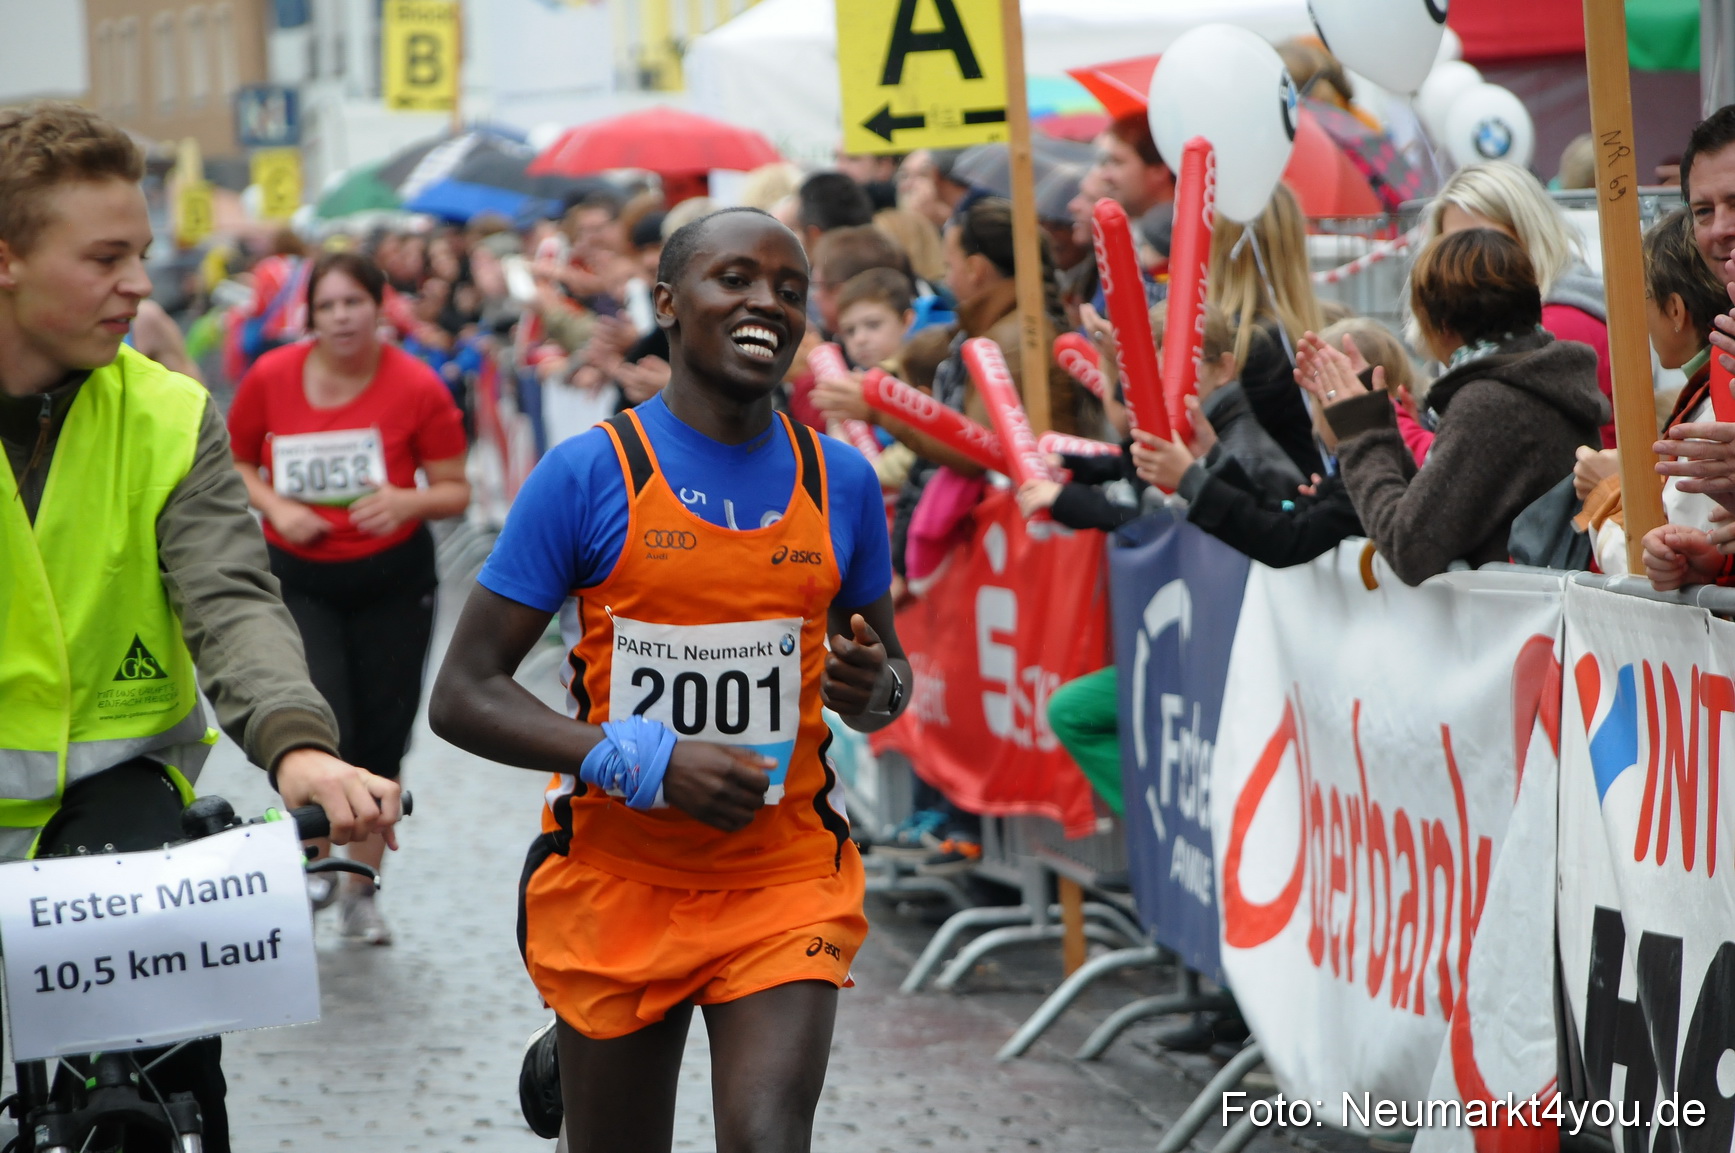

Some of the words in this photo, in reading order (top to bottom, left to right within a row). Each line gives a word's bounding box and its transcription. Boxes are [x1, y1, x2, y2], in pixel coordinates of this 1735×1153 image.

[406, 33, 443, 87] B
[879, 0, 985, 86] A
[645, 552, 668, 561] Audi
[789, 550, 822, 565] asics
[617, 635, 679, 661] PARTL
[684, 641, 773, 661] Neumarkt
[631, 666, 781, 736] 2001
[1634, 658, 1735, 879] INT
[1222, 680, 1493, 1023] Oberbank
[29, 892, 144, 928] Erster
[155, 870, 269, 910] Mann
[33, 955, 116, 993] 10,5
[128, 950, 187, 980] km
[200, 928, 282, 968] Lauf
